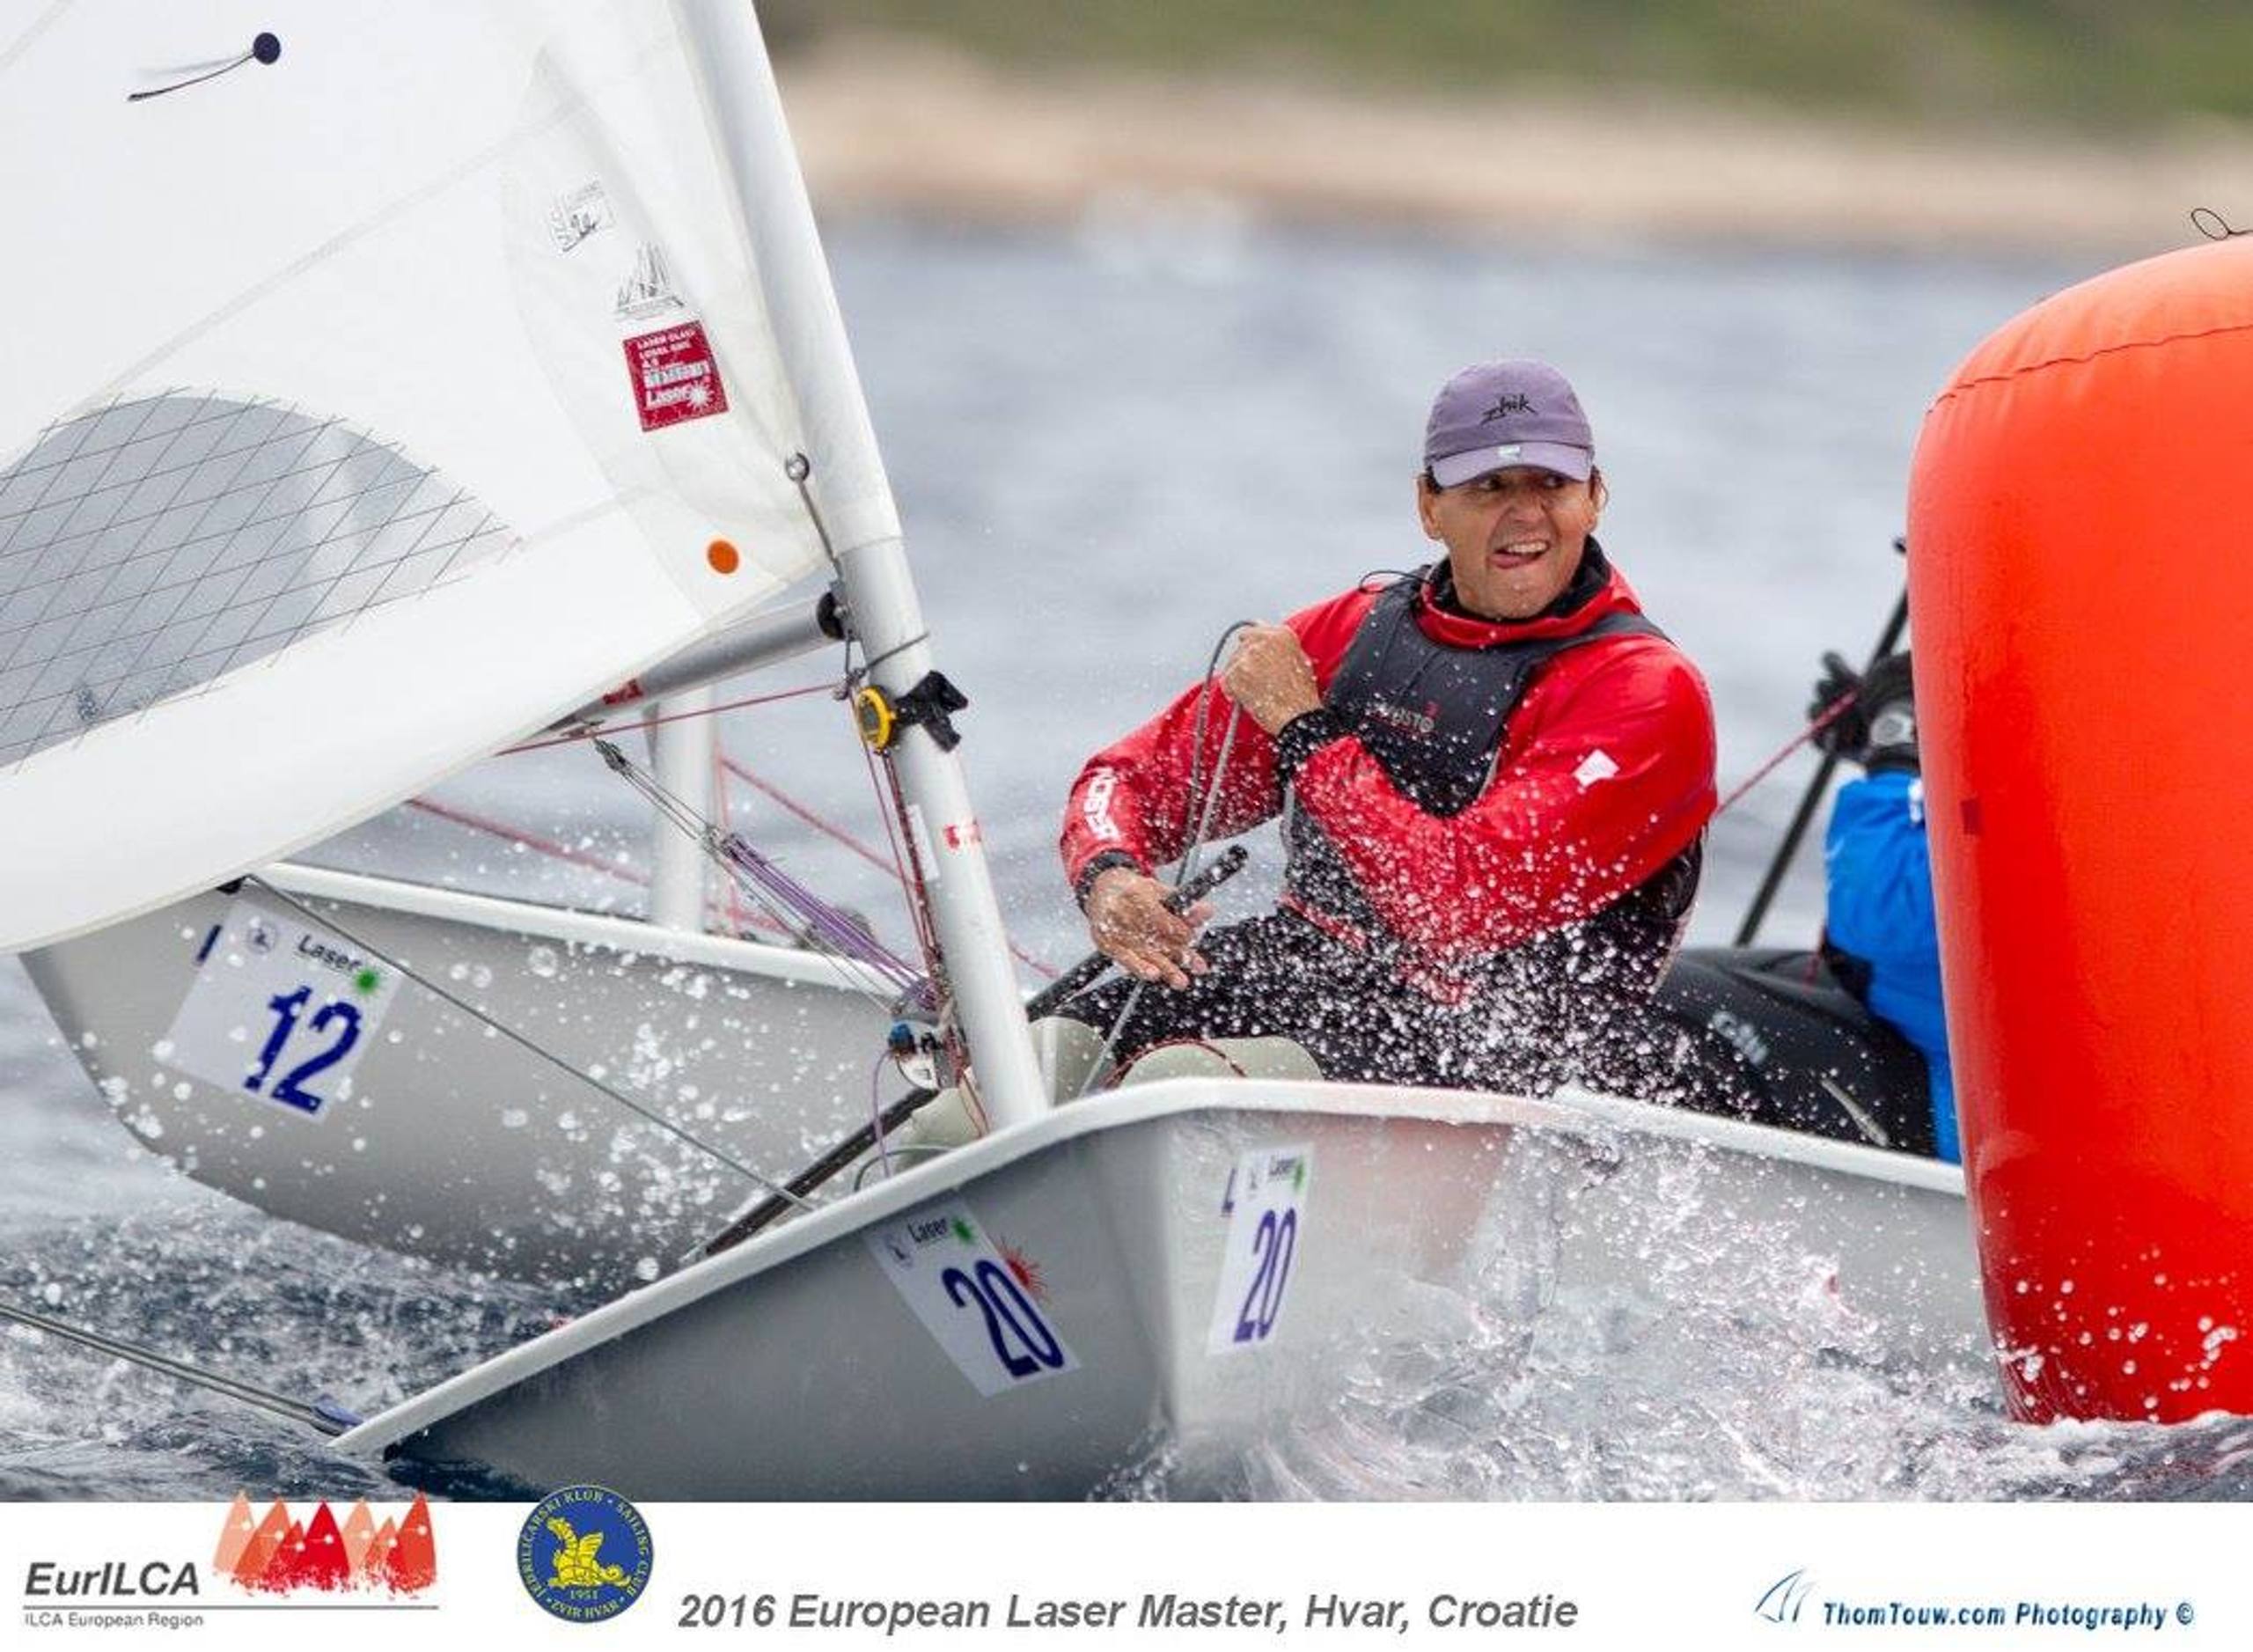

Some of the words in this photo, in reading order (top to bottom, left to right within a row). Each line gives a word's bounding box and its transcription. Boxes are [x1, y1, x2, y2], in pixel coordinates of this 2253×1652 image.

[1480, 394, 1537, 426] zhik
[297, 934, 363, 973] Laser
[244, 984, 363, 1114] 12
[907, 1217, 948, 1244] Laser
[1234, 1208, 1296, 1342] 20
[942, 1259, 1063, 1377] 20
